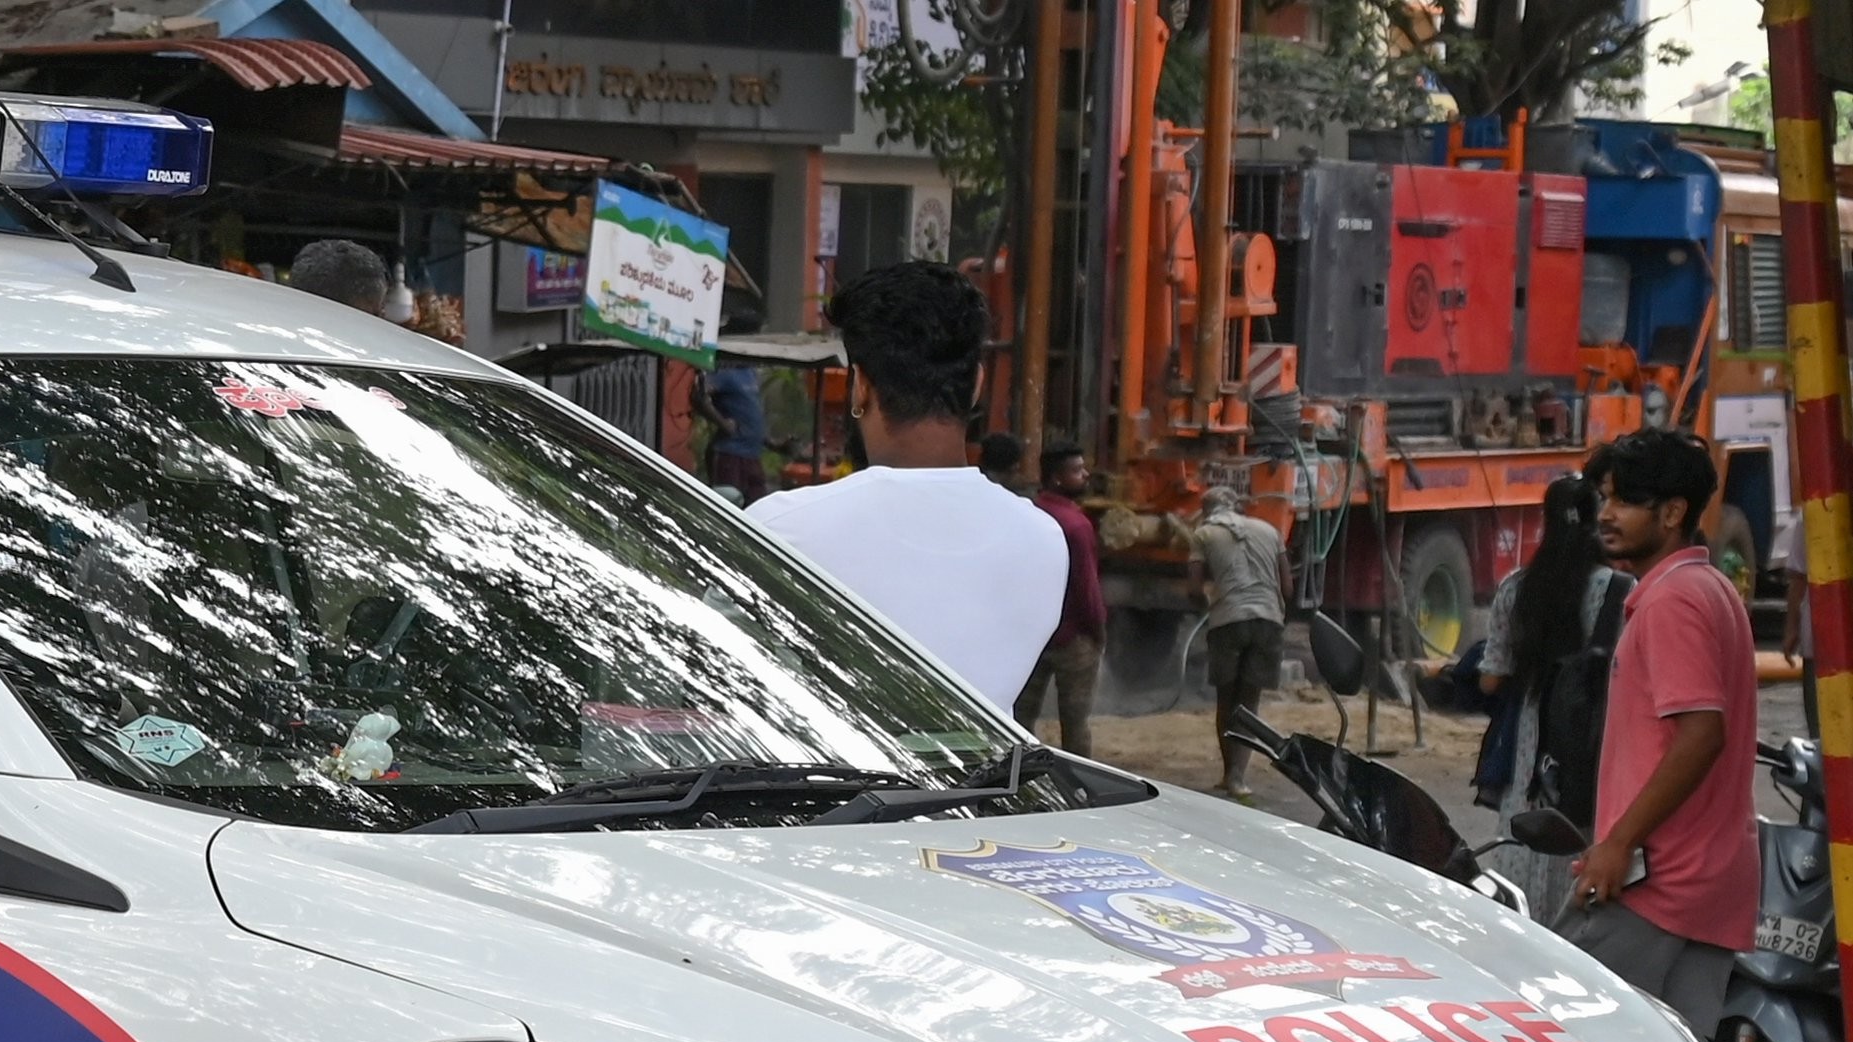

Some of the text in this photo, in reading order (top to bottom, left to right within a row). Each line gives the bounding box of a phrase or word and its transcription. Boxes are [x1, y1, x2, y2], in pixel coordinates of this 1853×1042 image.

[147, 169, 191, 184] DURATONE
[667, 281, 694, 303] ಮೂಲ
[1796, 924, 1820, 943] 02
